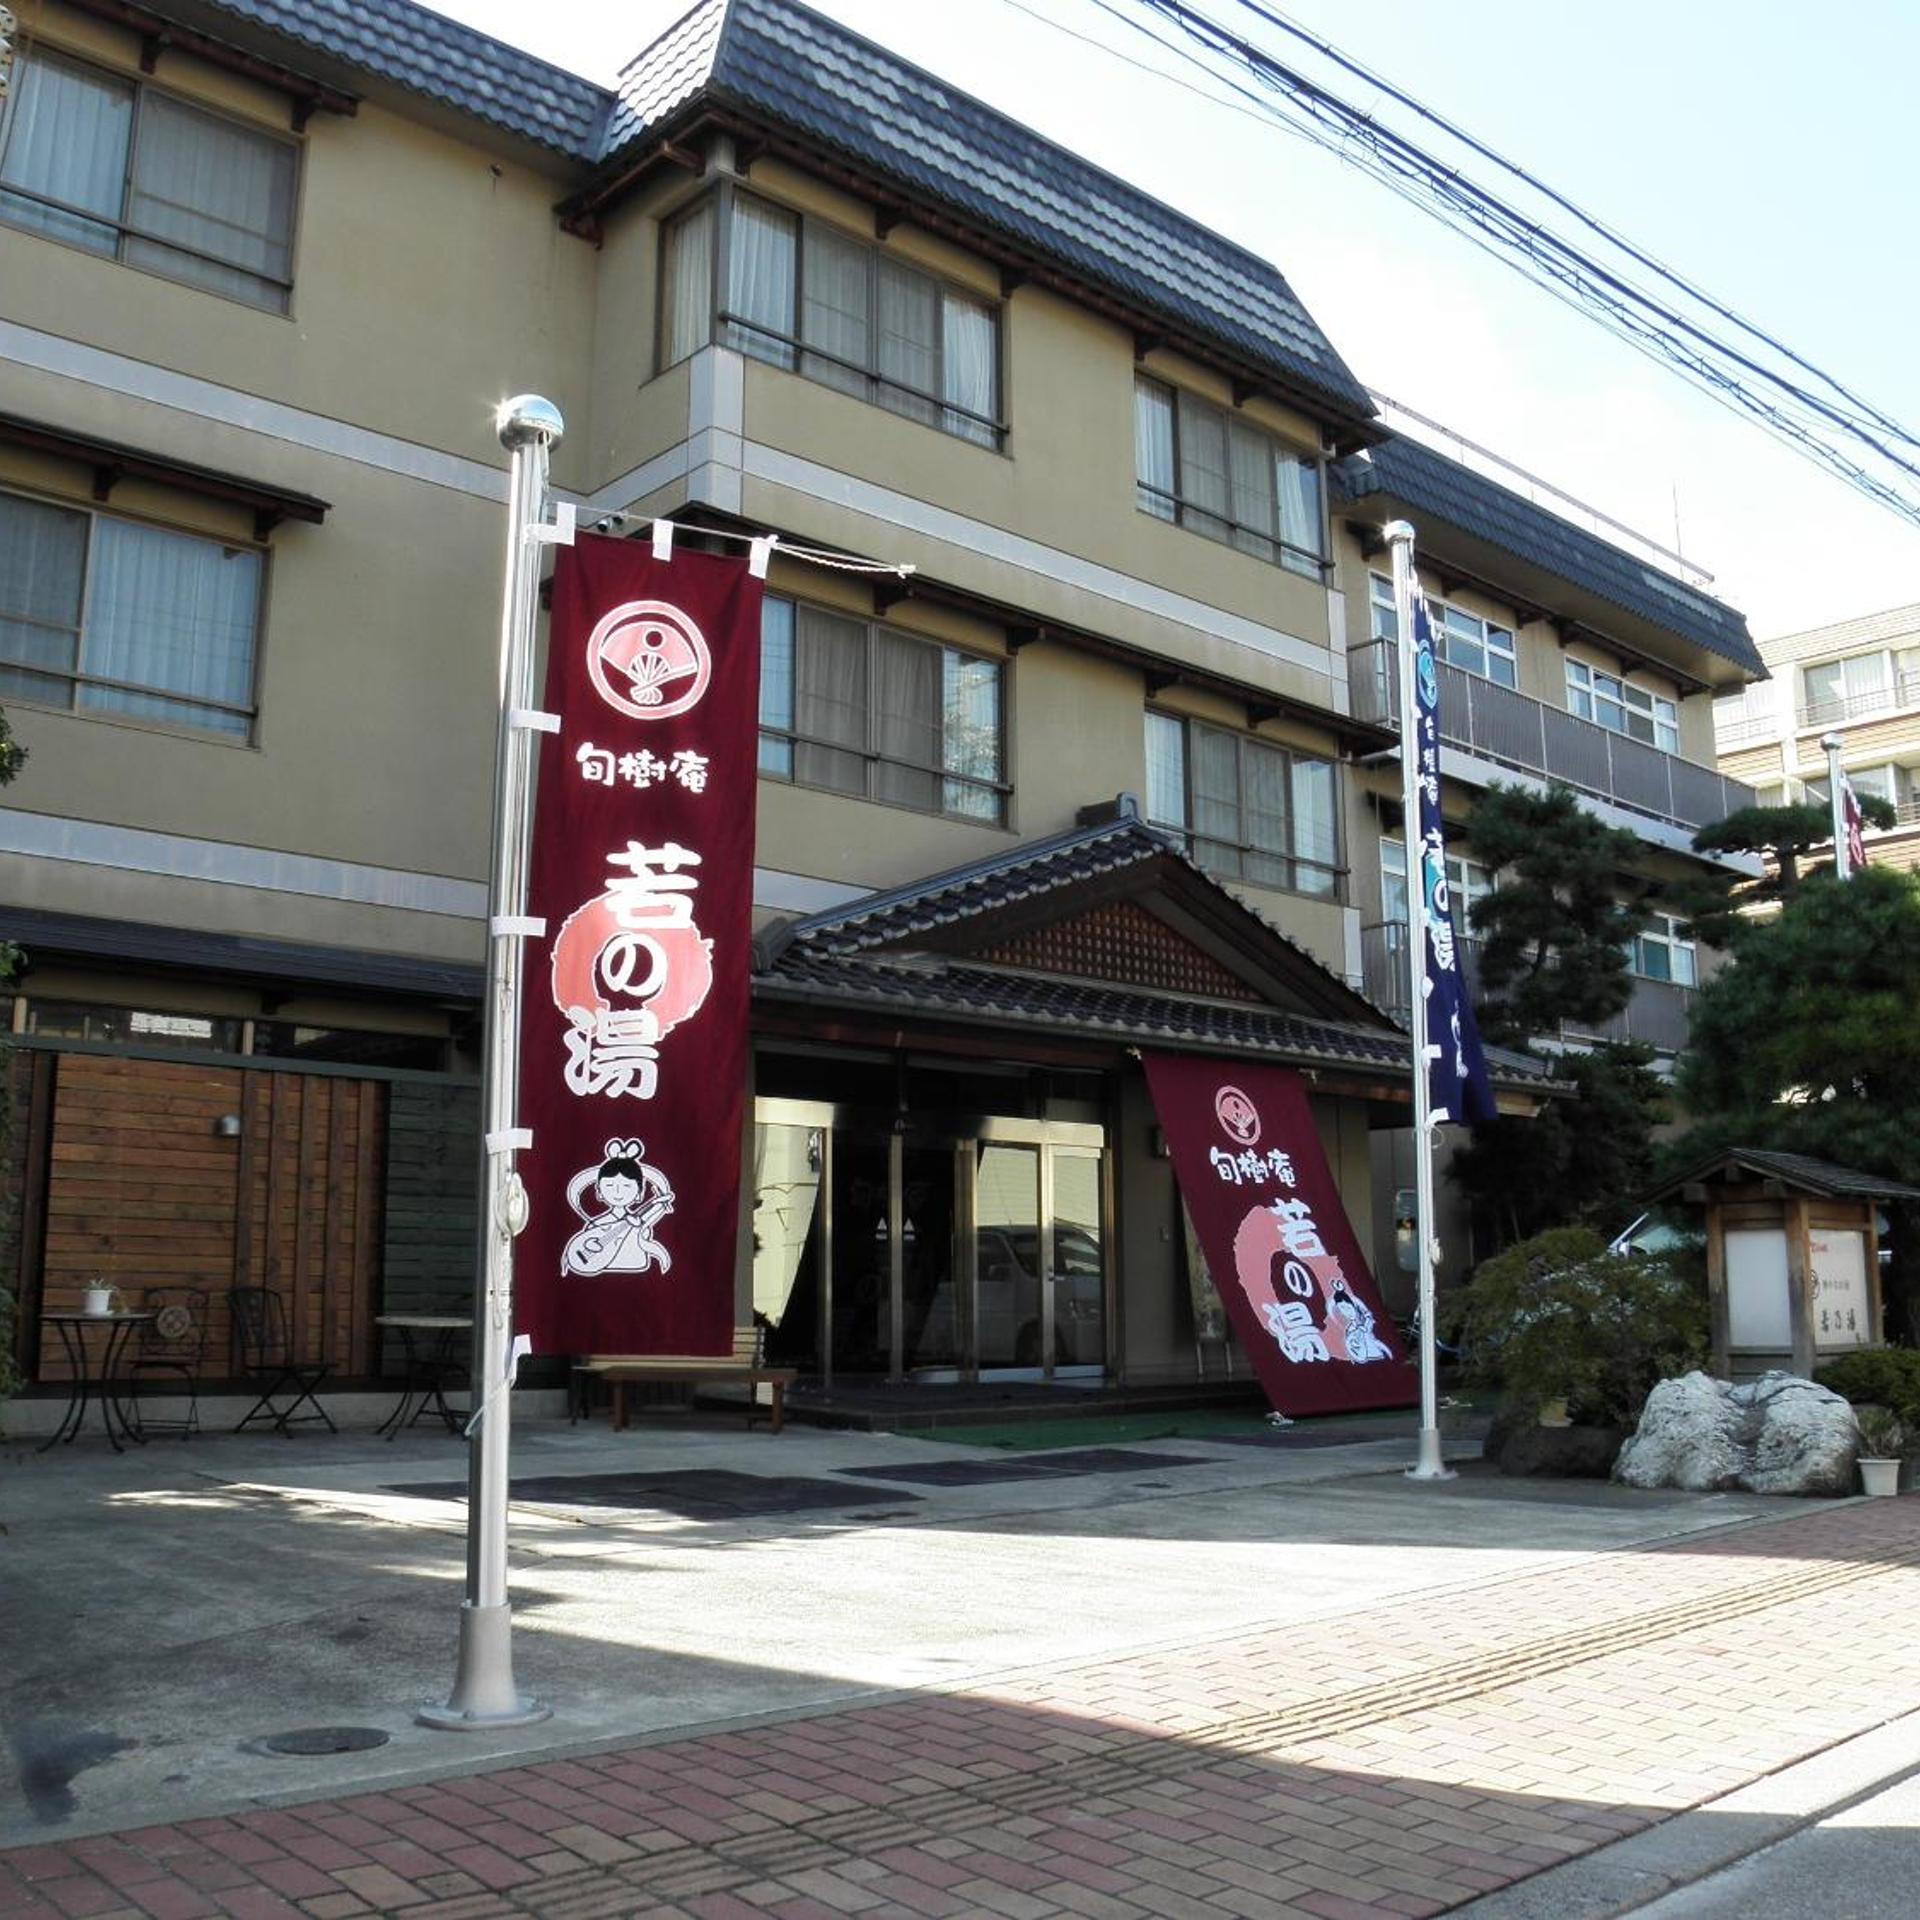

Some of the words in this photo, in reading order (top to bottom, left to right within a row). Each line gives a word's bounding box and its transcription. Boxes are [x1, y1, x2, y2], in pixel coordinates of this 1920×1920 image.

[576, 742, 710, 792] 旬樹庵
[564, 841, 702, 1099] 若の湯
[1210, 1146, 1297, 1188] 旬樹庵
[1262, 1198, 1330, 1363] 若の湯
